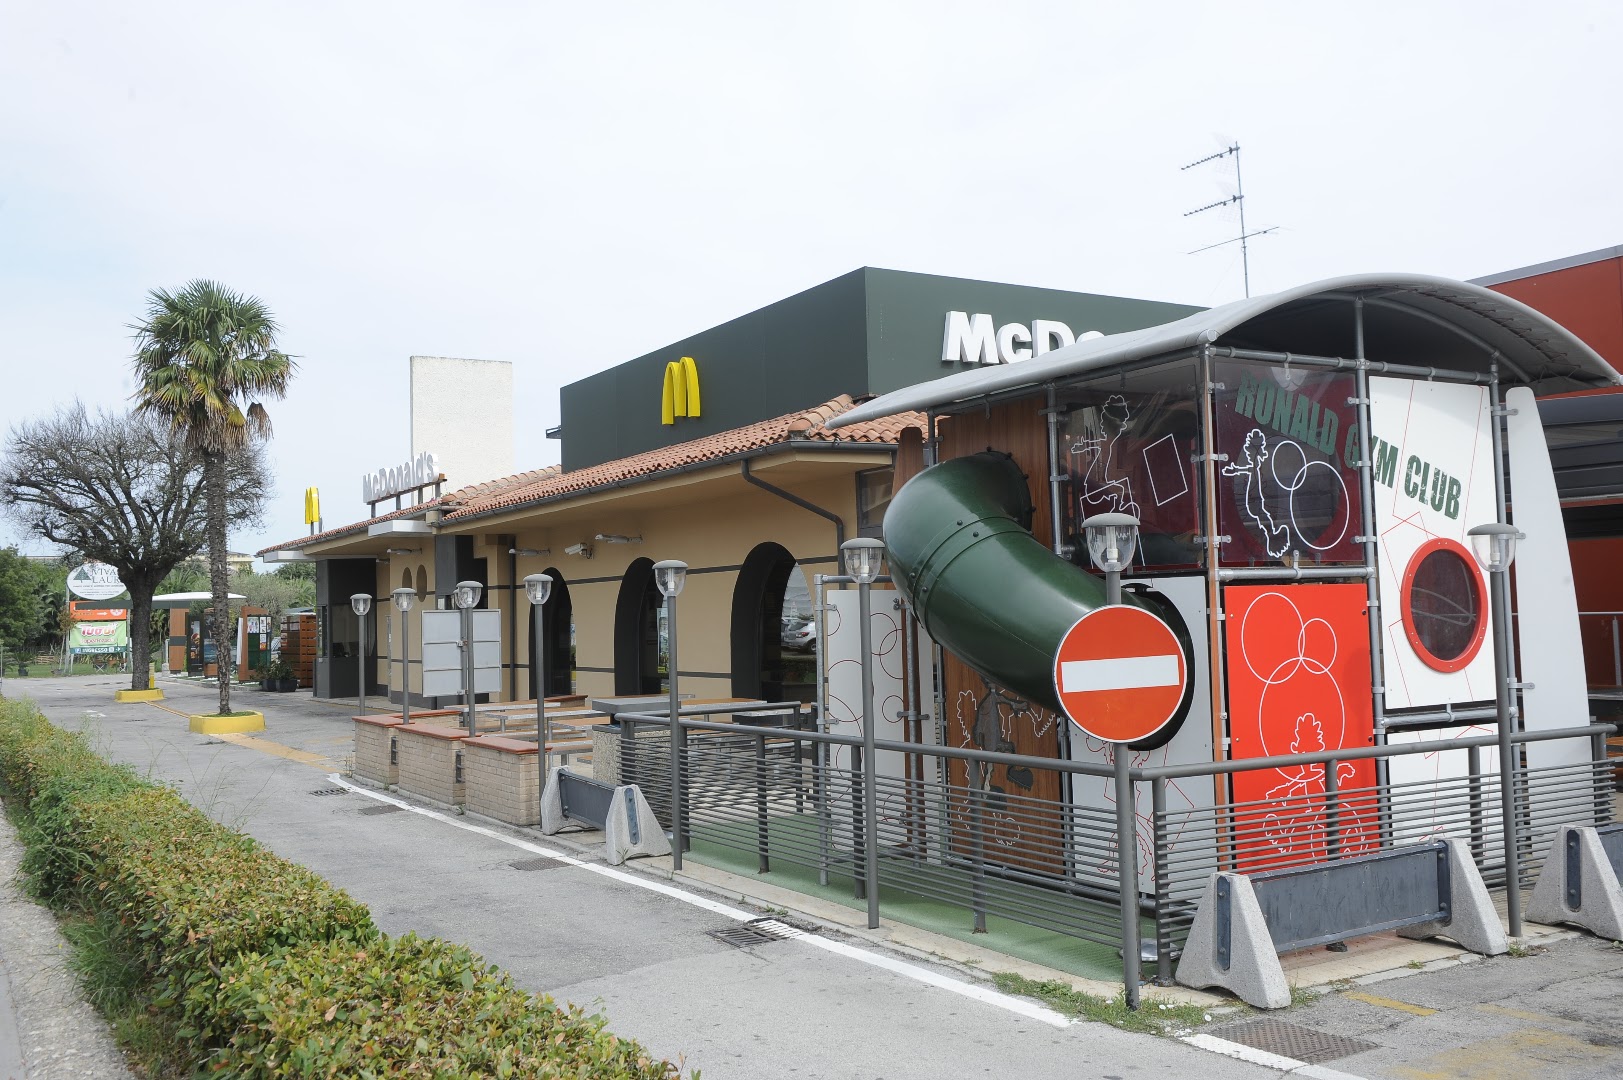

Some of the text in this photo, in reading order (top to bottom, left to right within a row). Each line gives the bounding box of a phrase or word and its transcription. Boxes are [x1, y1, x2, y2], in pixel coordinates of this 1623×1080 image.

[941, 310, 1106, 365] McD
[1234, 368, 1462, 521] RONALD GM CLUB
[362, 450, 440, 504] McDonald's
[92, 568, 118, 576] VIVA
[92, 576, 121, 584] LAUR
